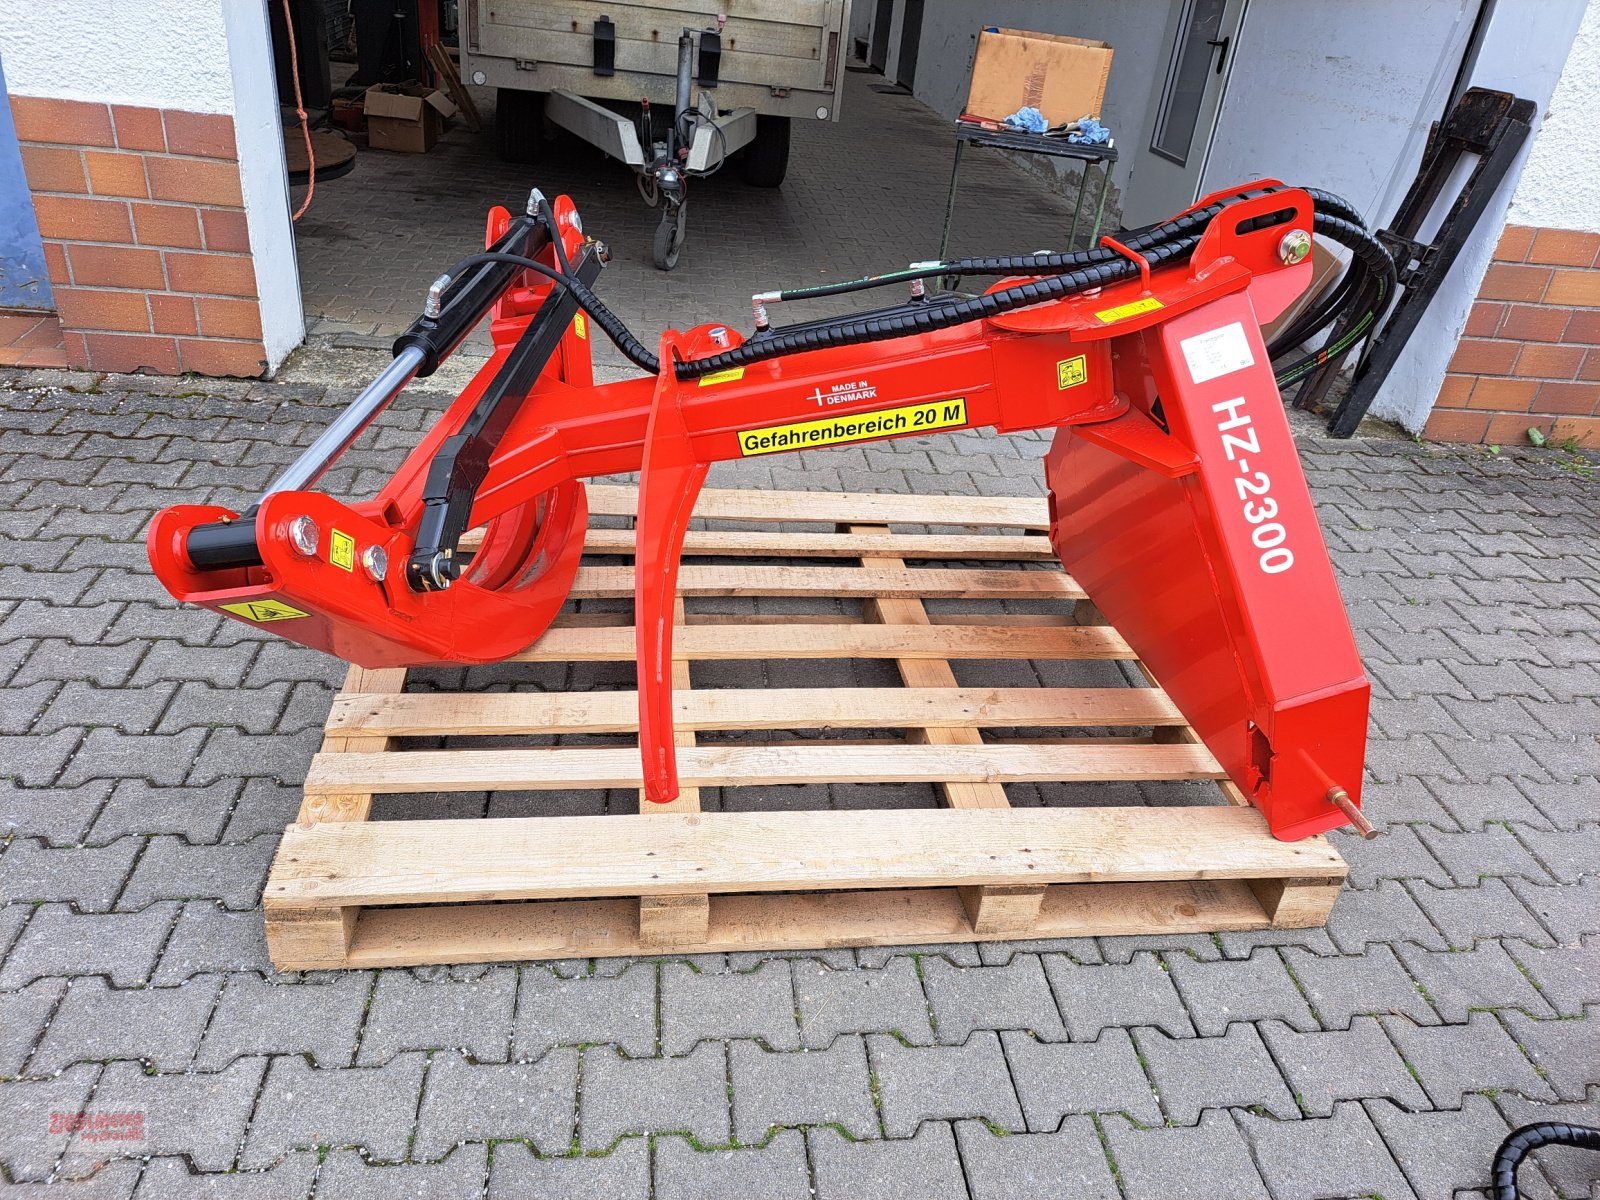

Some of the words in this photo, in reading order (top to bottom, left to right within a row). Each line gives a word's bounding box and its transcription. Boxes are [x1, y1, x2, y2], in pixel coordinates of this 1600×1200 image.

[827, 389, 877, 404] DENMARK
[832, 381, 857, 392] MADE
[859, 380, 868, 388] IN
[744, 413, 907, 451] Gefahrenbereich
[913, 408, 937, 426] 20
[943, 404, 960, 421] M
[1212, 396, 1294, 574] HZ-2300
